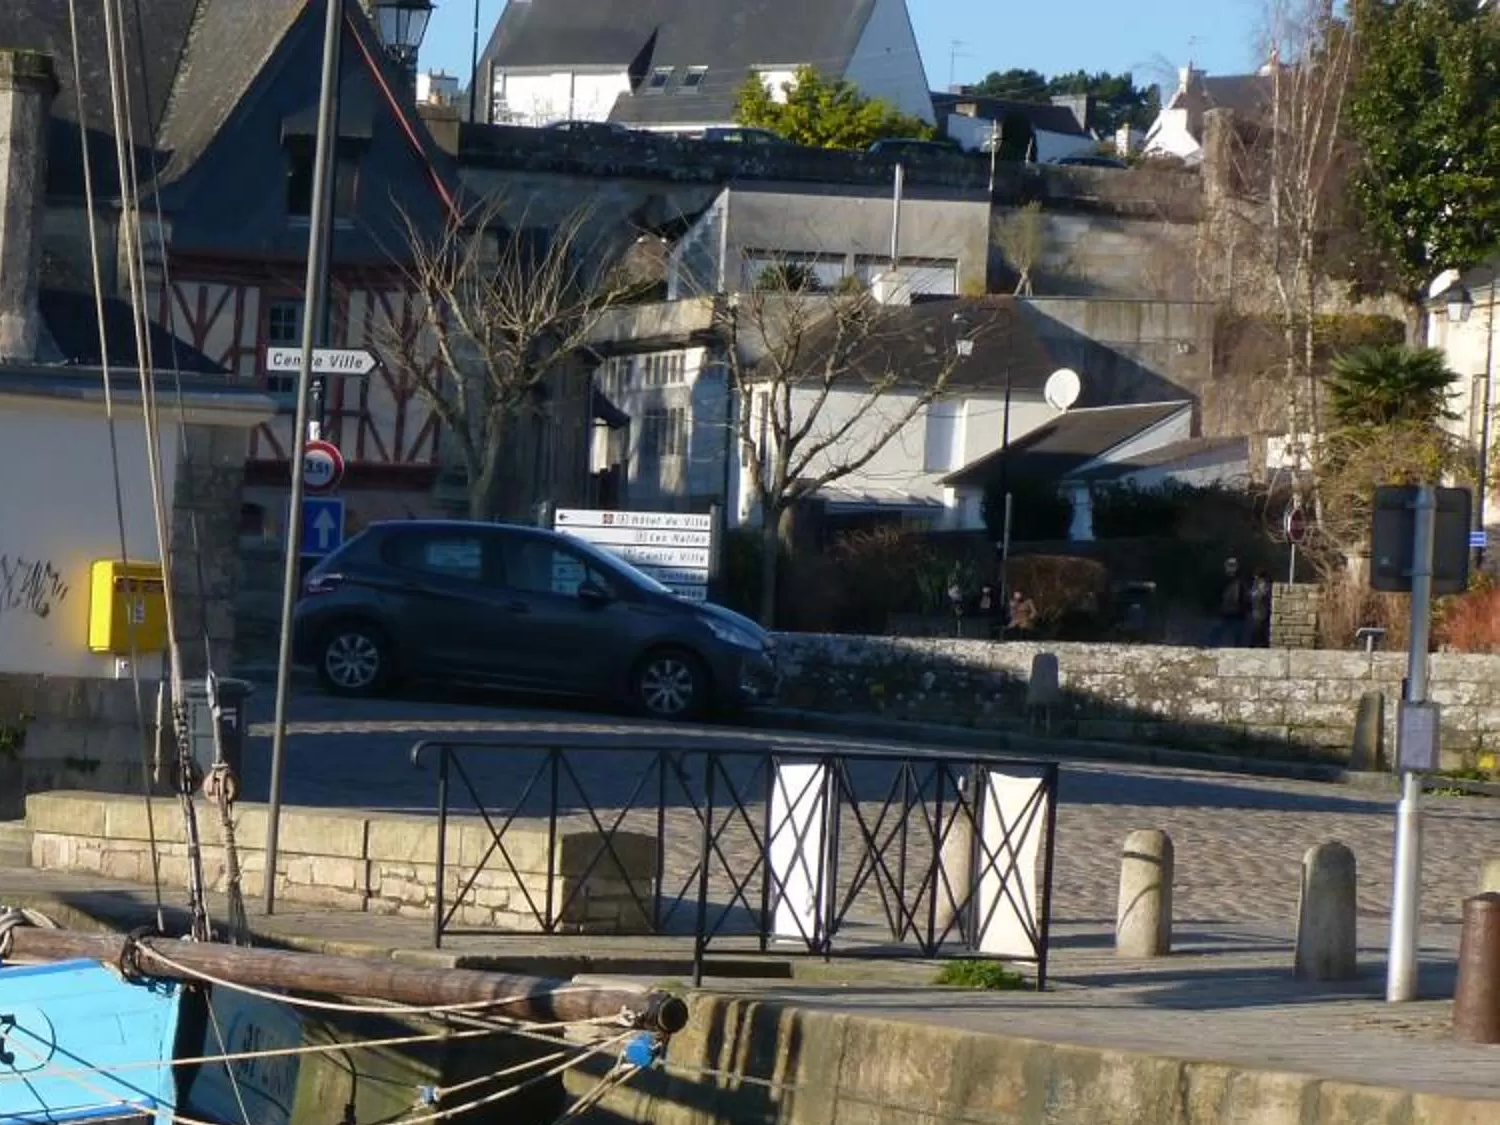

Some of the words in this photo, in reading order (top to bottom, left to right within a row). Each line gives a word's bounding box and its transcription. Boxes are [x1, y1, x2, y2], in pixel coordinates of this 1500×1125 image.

[273, 352, 323, 367] Cene
[330, 354, 363, 369] Ville
[684, 514, 709, 527] Ville
